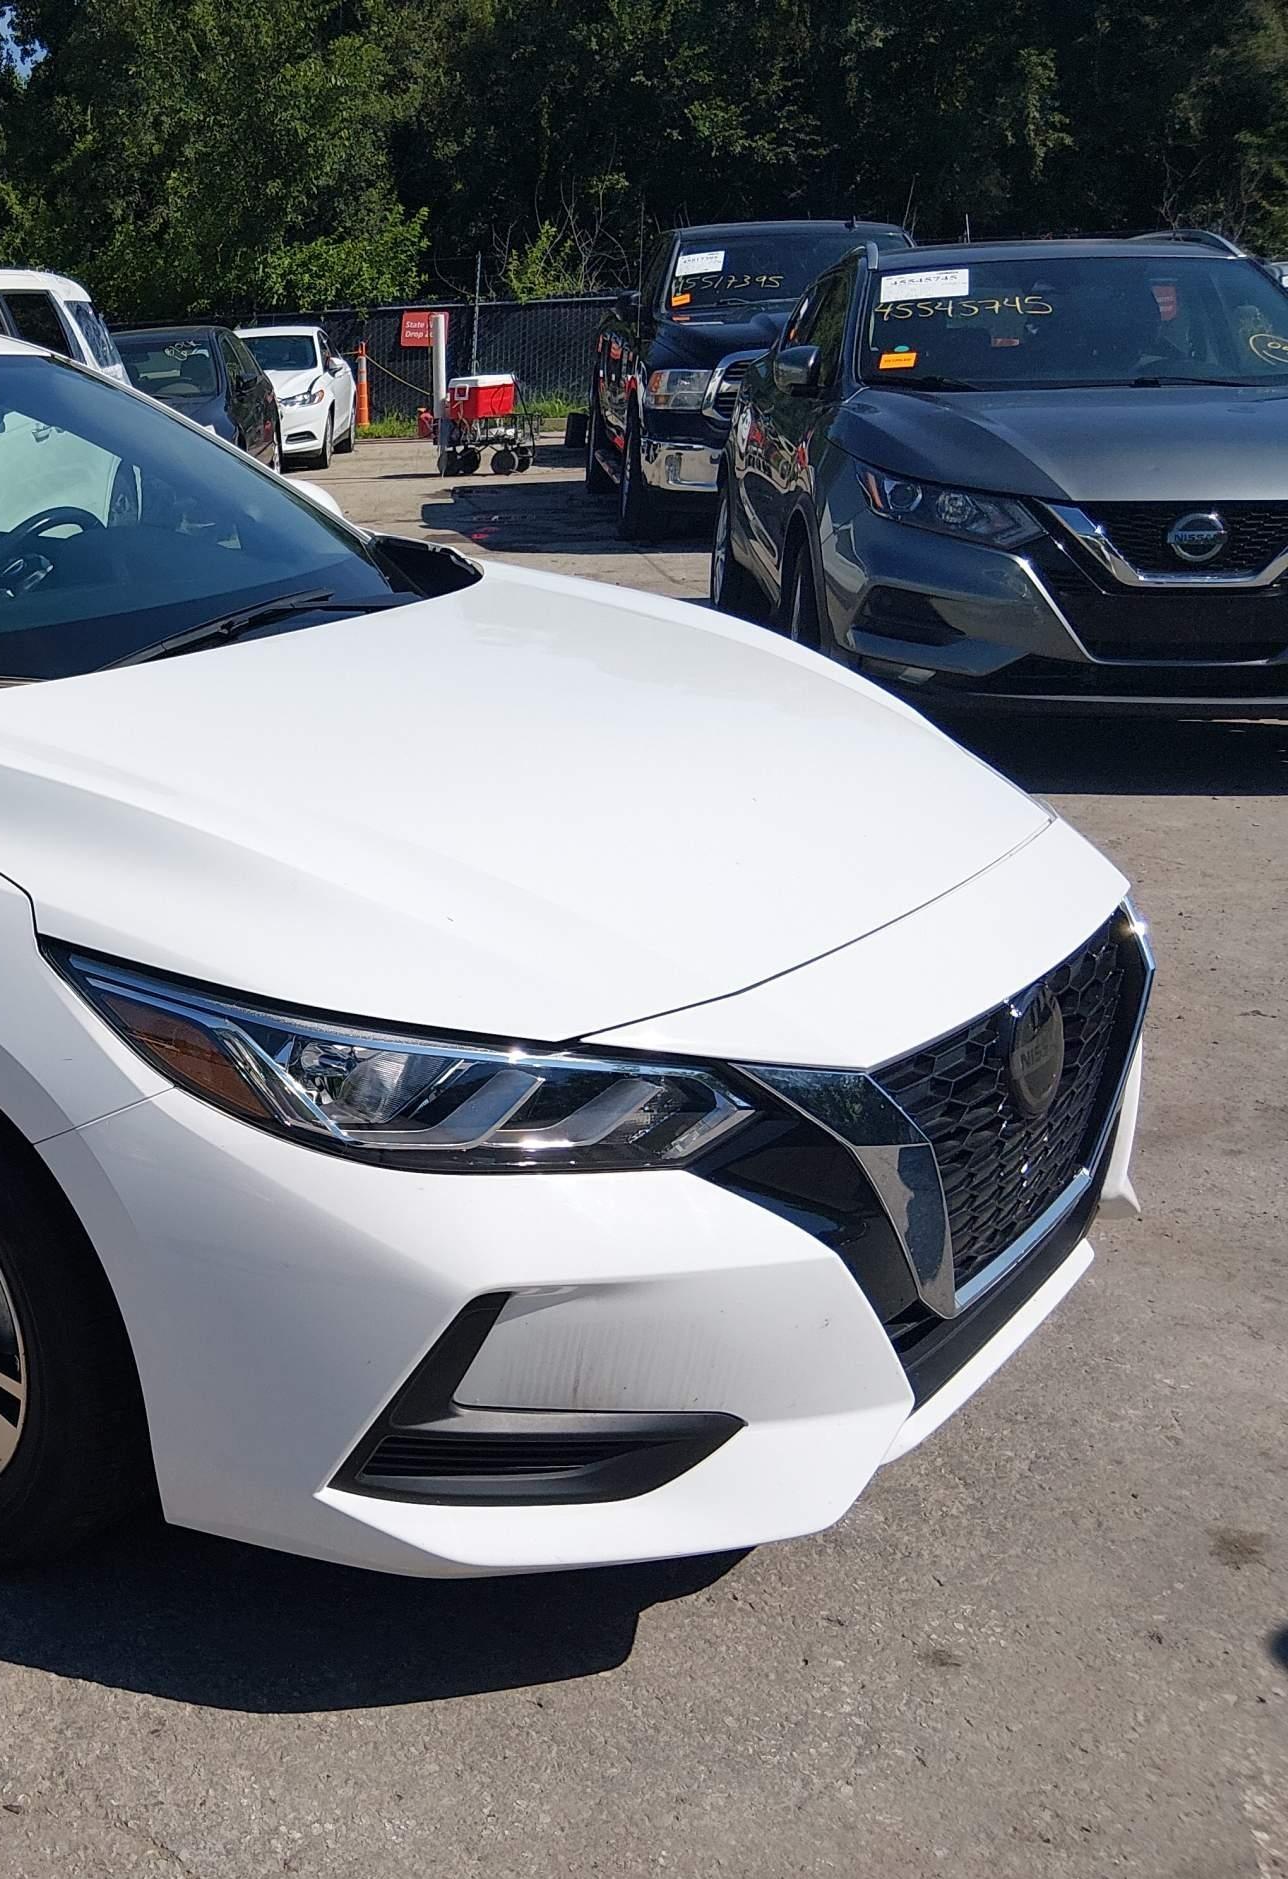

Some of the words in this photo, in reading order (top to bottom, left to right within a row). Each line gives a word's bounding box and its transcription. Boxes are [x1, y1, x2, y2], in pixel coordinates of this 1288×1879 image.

[874, 296, 1053, 321] 45545745
[406, 321, 425, 329] State
[405, 331, 423, 339] Drop
